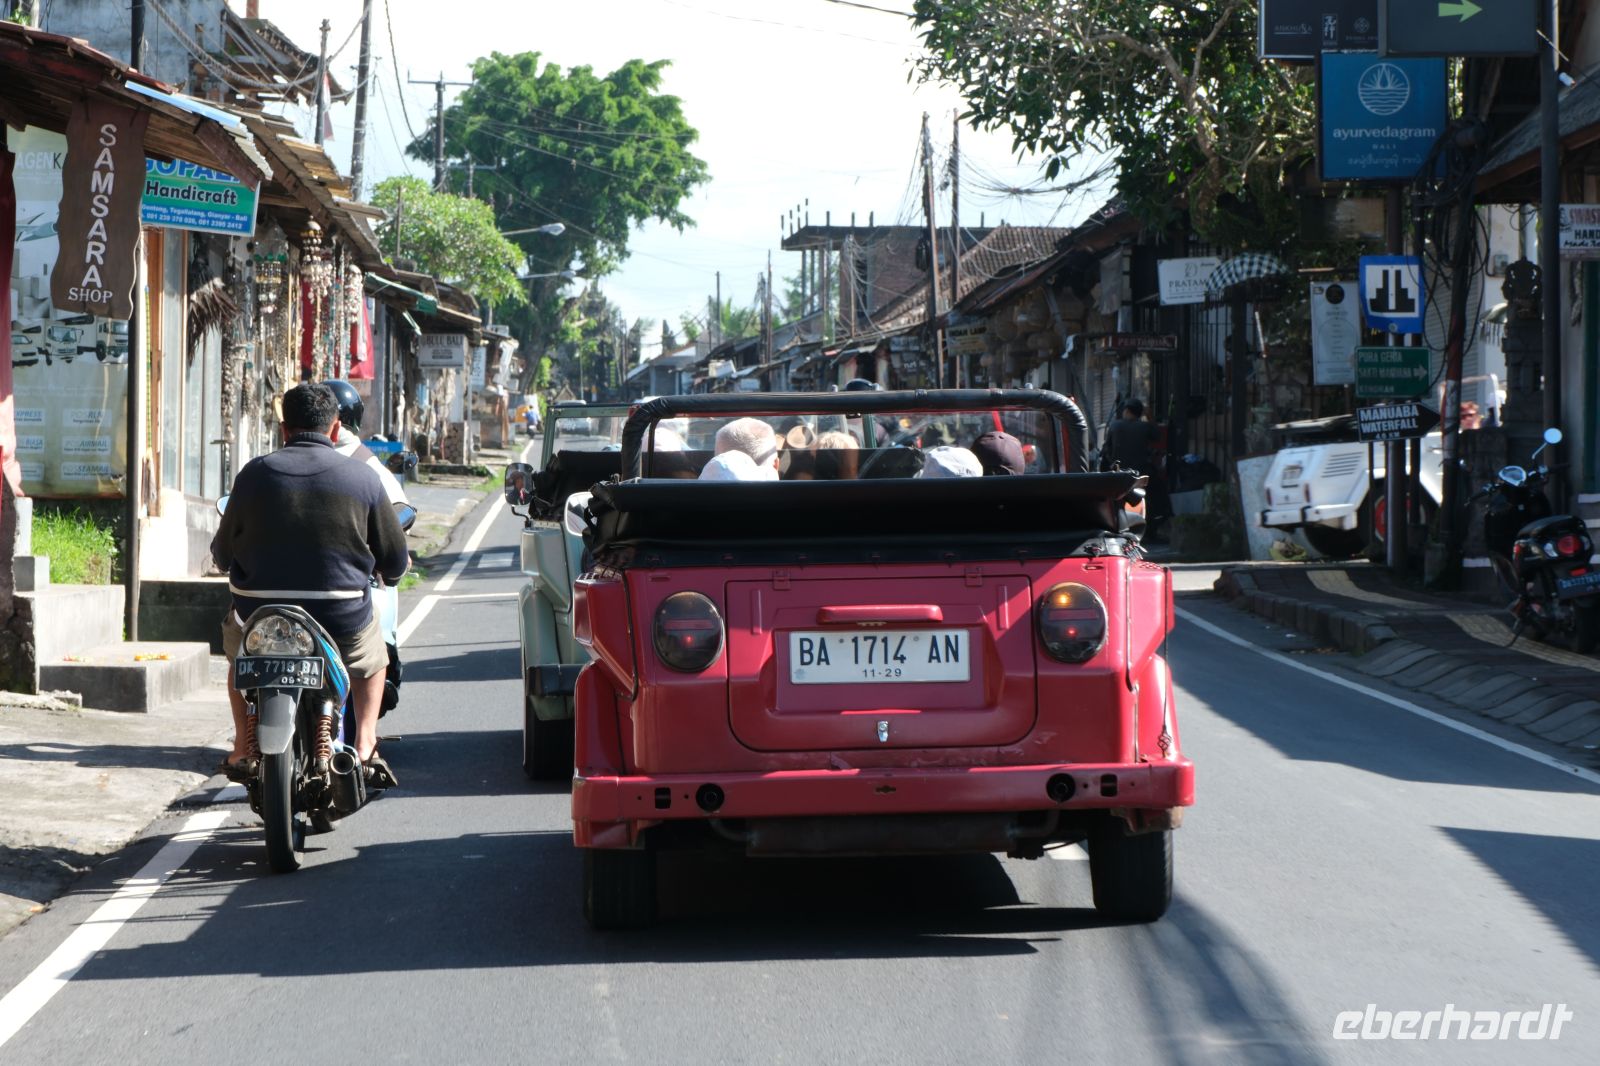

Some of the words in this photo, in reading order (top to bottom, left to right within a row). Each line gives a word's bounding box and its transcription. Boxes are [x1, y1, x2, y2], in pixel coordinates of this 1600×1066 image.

[1333, 125, 1436, 140] ayurvedagram
[145, 181, 238, 205] Handicraft
[82, 123, 117, 288] SAMSARA
[235, 214, 248, 222] Bali
[68, 287, 113, 304] SHOP
[1360, 405, 1419, 421] MANUABA
[1360, 418, 1419, 434] WATERFALL
[799, 637, 830, 666] BA
[851, 635, 907, 665] 1714
[928, 634, 959, 663] AN
[238, 660, 255, 676] DK
[302, 660, 319, 675] BA
